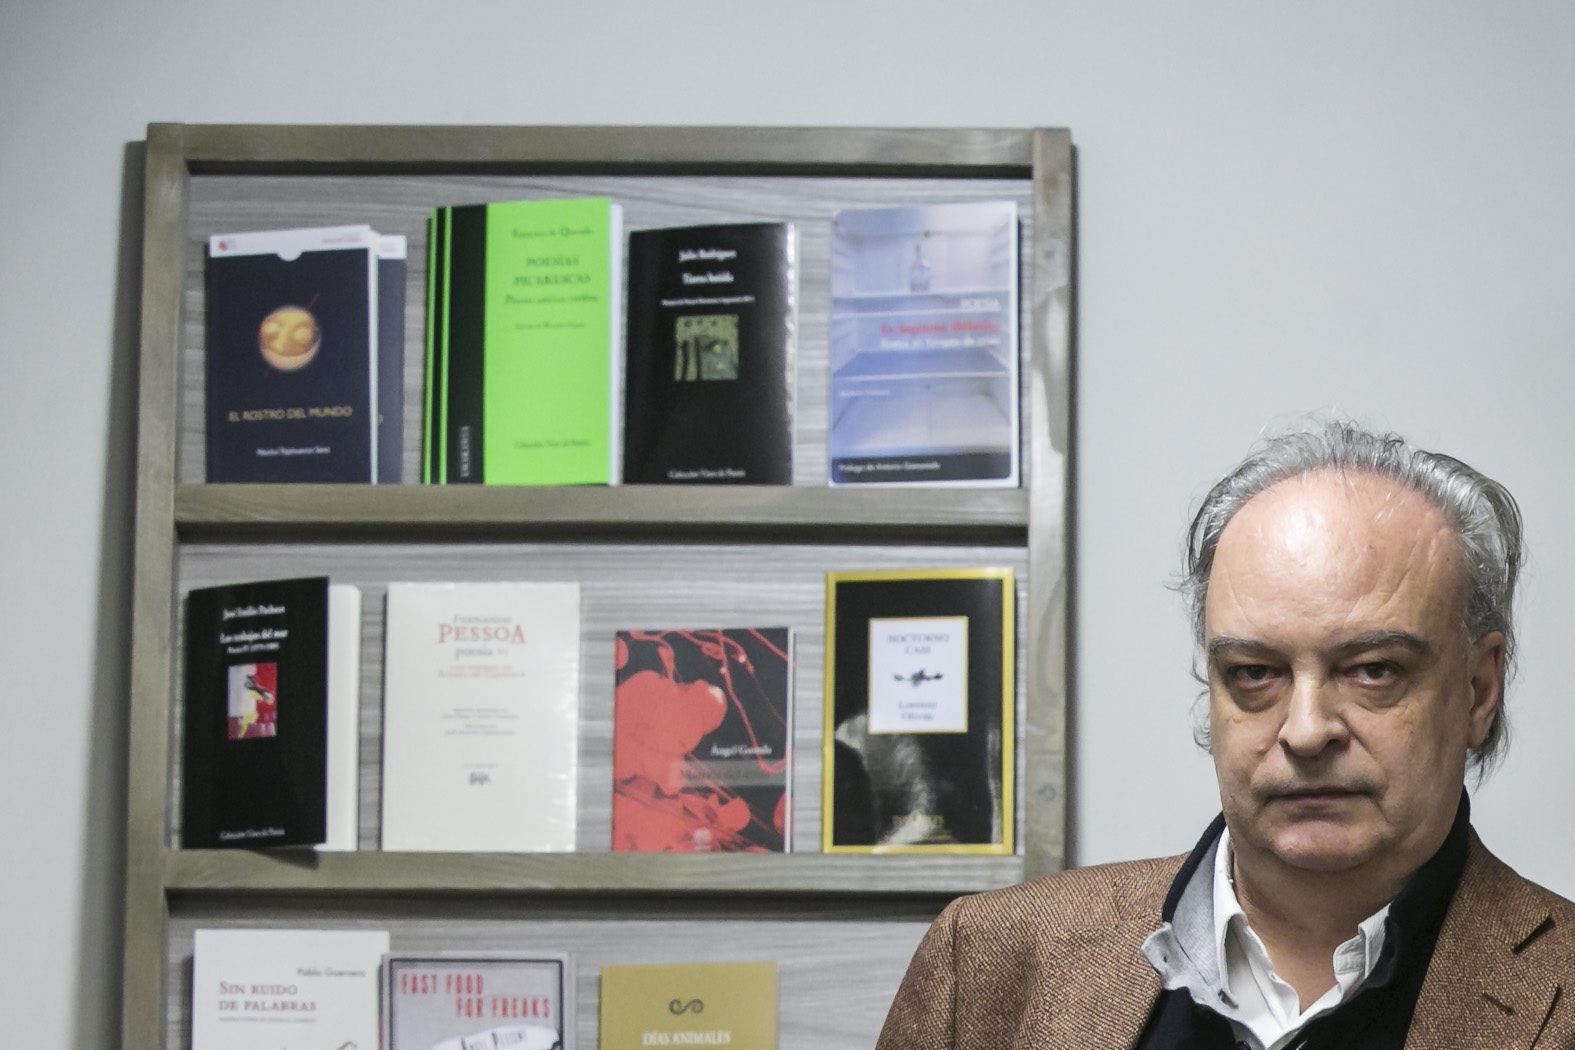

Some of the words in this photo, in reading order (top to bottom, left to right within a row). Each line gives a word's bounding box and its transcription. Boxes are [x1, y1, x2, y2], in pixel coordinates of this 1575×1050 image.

[286, 407, 306, 419] DEL
[308, 405, 353, 418] MUNDO
[437, 622, 527, 645] PESSOA
[251, 983, 298, 995] RUIDO
[401, 973, 437, 994] FAST
[445, 974, 484, 995] FOOD
[219, 1000, 238, 1011] DE
[243, 1000, 317, 1012] PALABRAS
[456, 996, 484, 1018] FOR
[492, 996, 551, 1018] FREAKS
[671, 1029, 733, 1046] ANIMALES
